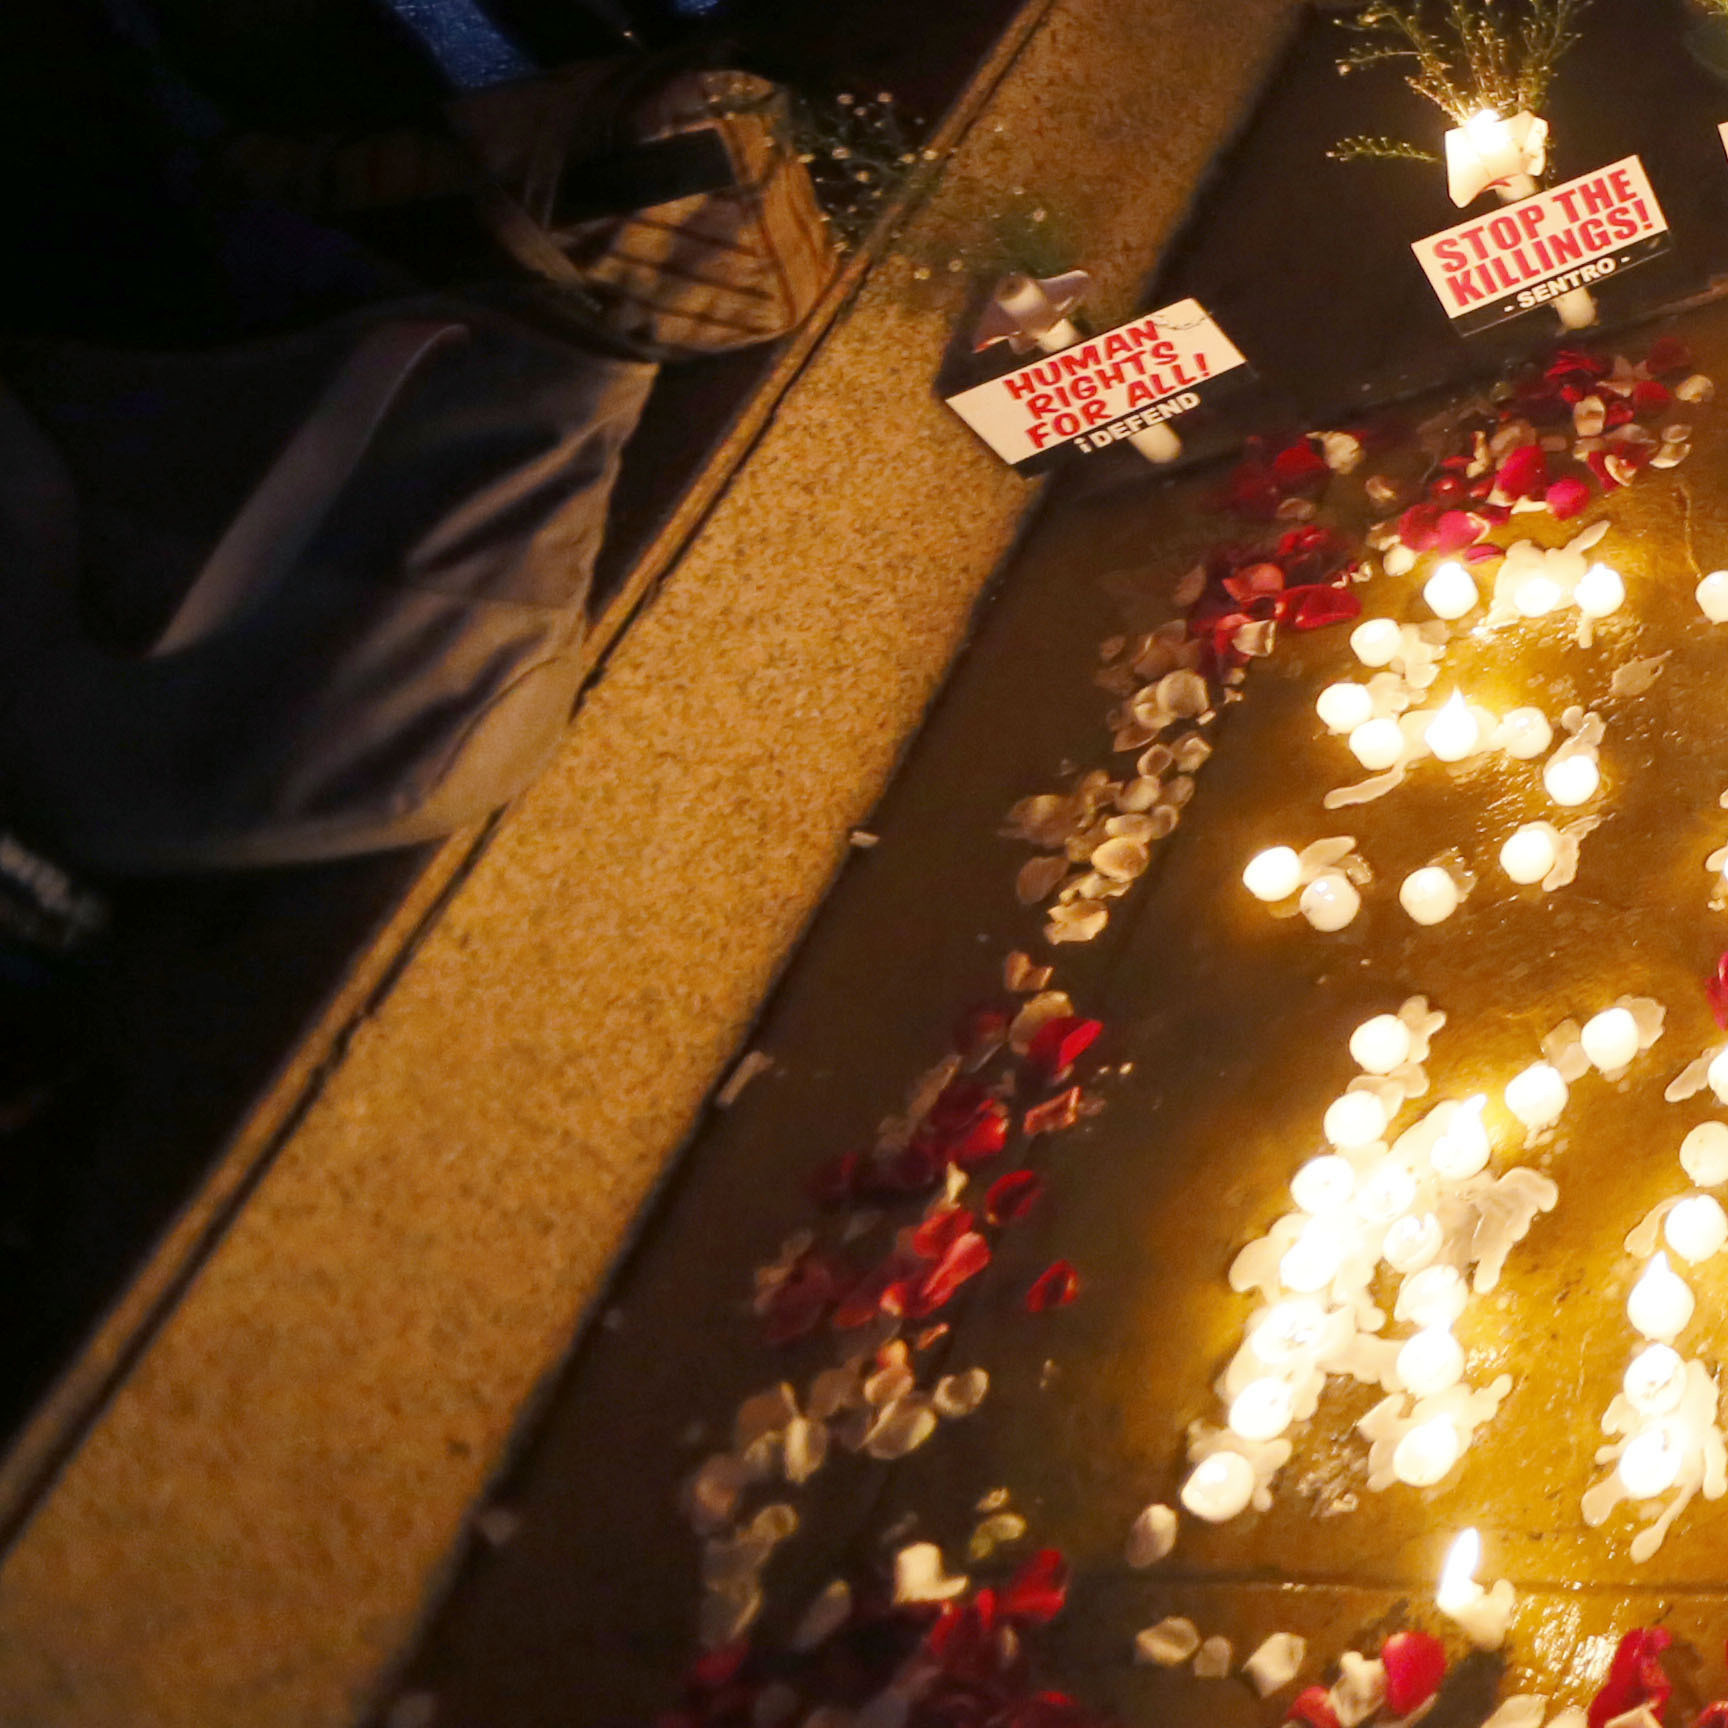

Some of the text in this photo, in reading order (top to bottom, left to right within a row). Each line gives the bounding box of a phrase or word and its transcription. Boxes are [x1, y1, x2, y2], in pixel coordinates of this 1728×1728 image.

[1433, 168, 1638, 274] STOP THE
[1445, 197, 1654, 308] KILLINGS!
[1516, 257, 1617, 309] SENTRO
[1001, 319, 1161, 401] HUMAN
[1023, 340, 1180, 421] RIGHTS
[1024, 352, 1212, 449] FOR ALL!
